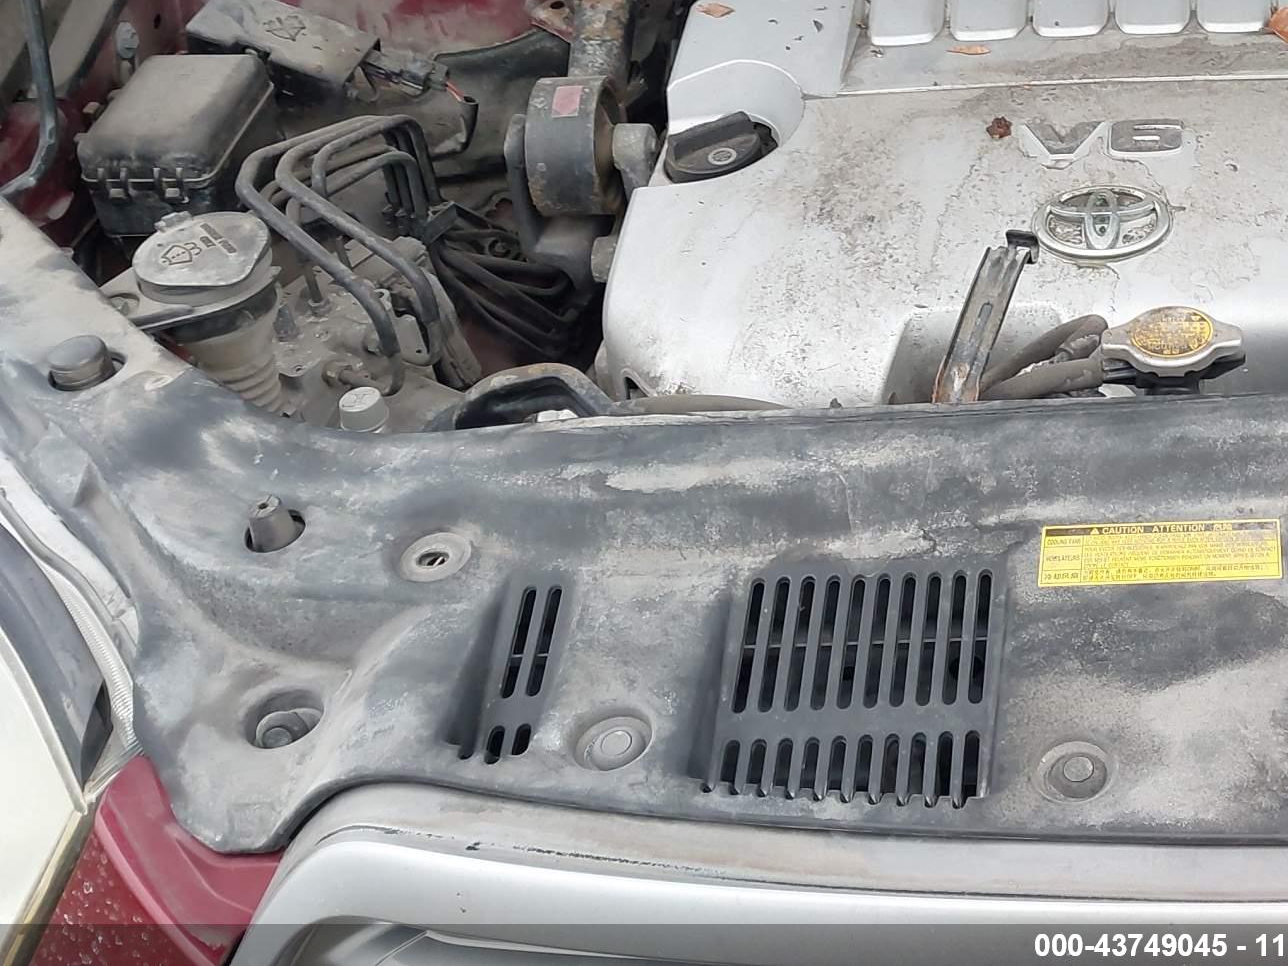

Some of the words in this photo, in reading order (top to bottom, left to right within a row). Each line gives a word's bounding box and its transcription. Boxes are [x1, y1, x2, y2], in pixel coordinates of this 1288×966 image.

[1020, 118, 1186, 164] V6
[1101, 526, 1145, 535] CAUTION
[1151, 524, 1206, 533] ATTENTION
